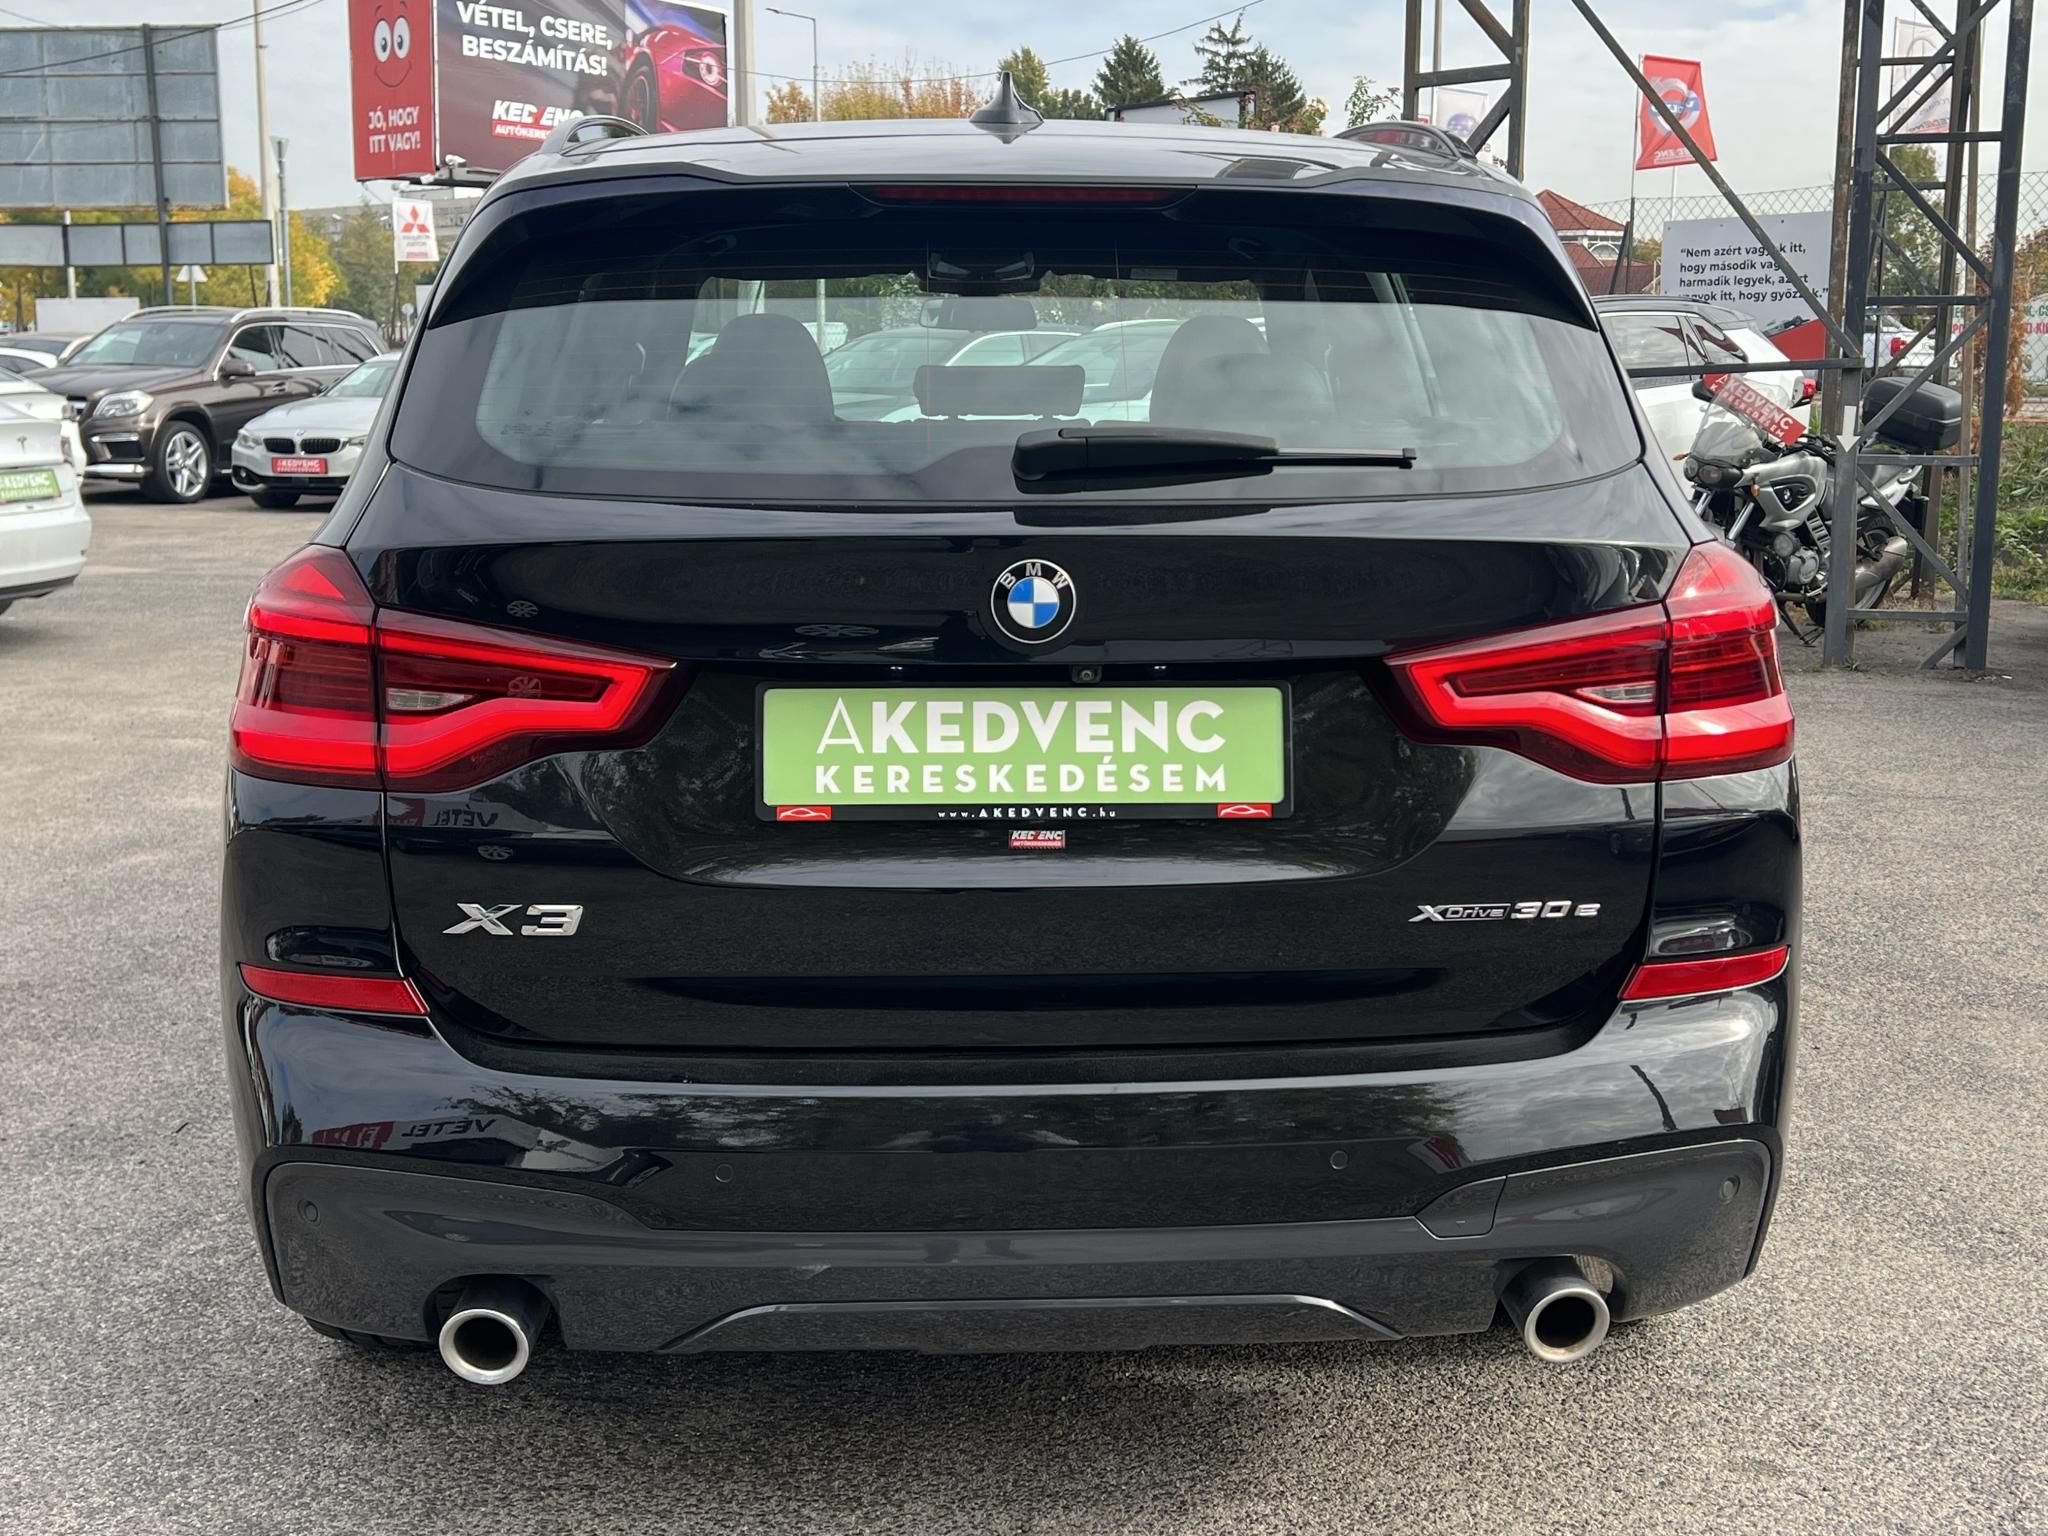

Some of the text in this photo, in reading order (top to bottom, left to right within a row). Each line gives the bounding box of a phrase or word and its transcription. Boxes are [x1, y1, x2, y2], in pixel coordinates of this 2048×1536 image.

[456, 0, 613, 50] VÉTEL, CSERE,
[462, 35, 608, 76] BESZÁMÍTÁS!
[368, 105, 420, 132] JÓ, HOGY
[369, 131, 421, 154] ITT VAGY!
[1714, 246, 1742, 256] azért
[1745, 243, 1786, 257] vagk
[1790, 242, 1806, 254] itt,
[1680, 263, 1707, 275] hogy
[1710, 260, 1757, 272] második
[1680, 275, 1731, 288] harmadik
[1734, 274, 1775, 287] legyek,
[1720, 290, 1736, 302] itt,
[1739, 290, 1769, 303] hogy
[999, 562, 1069, 590] BMW
[815, 696, 1227, 754] AKEDVENC
[815, 754, 1227, 794] KERESKEDÉSEM
[937, 806, 1116, 819] www.AKEDVENC.hu
[442, 903, 584, 936] X3
